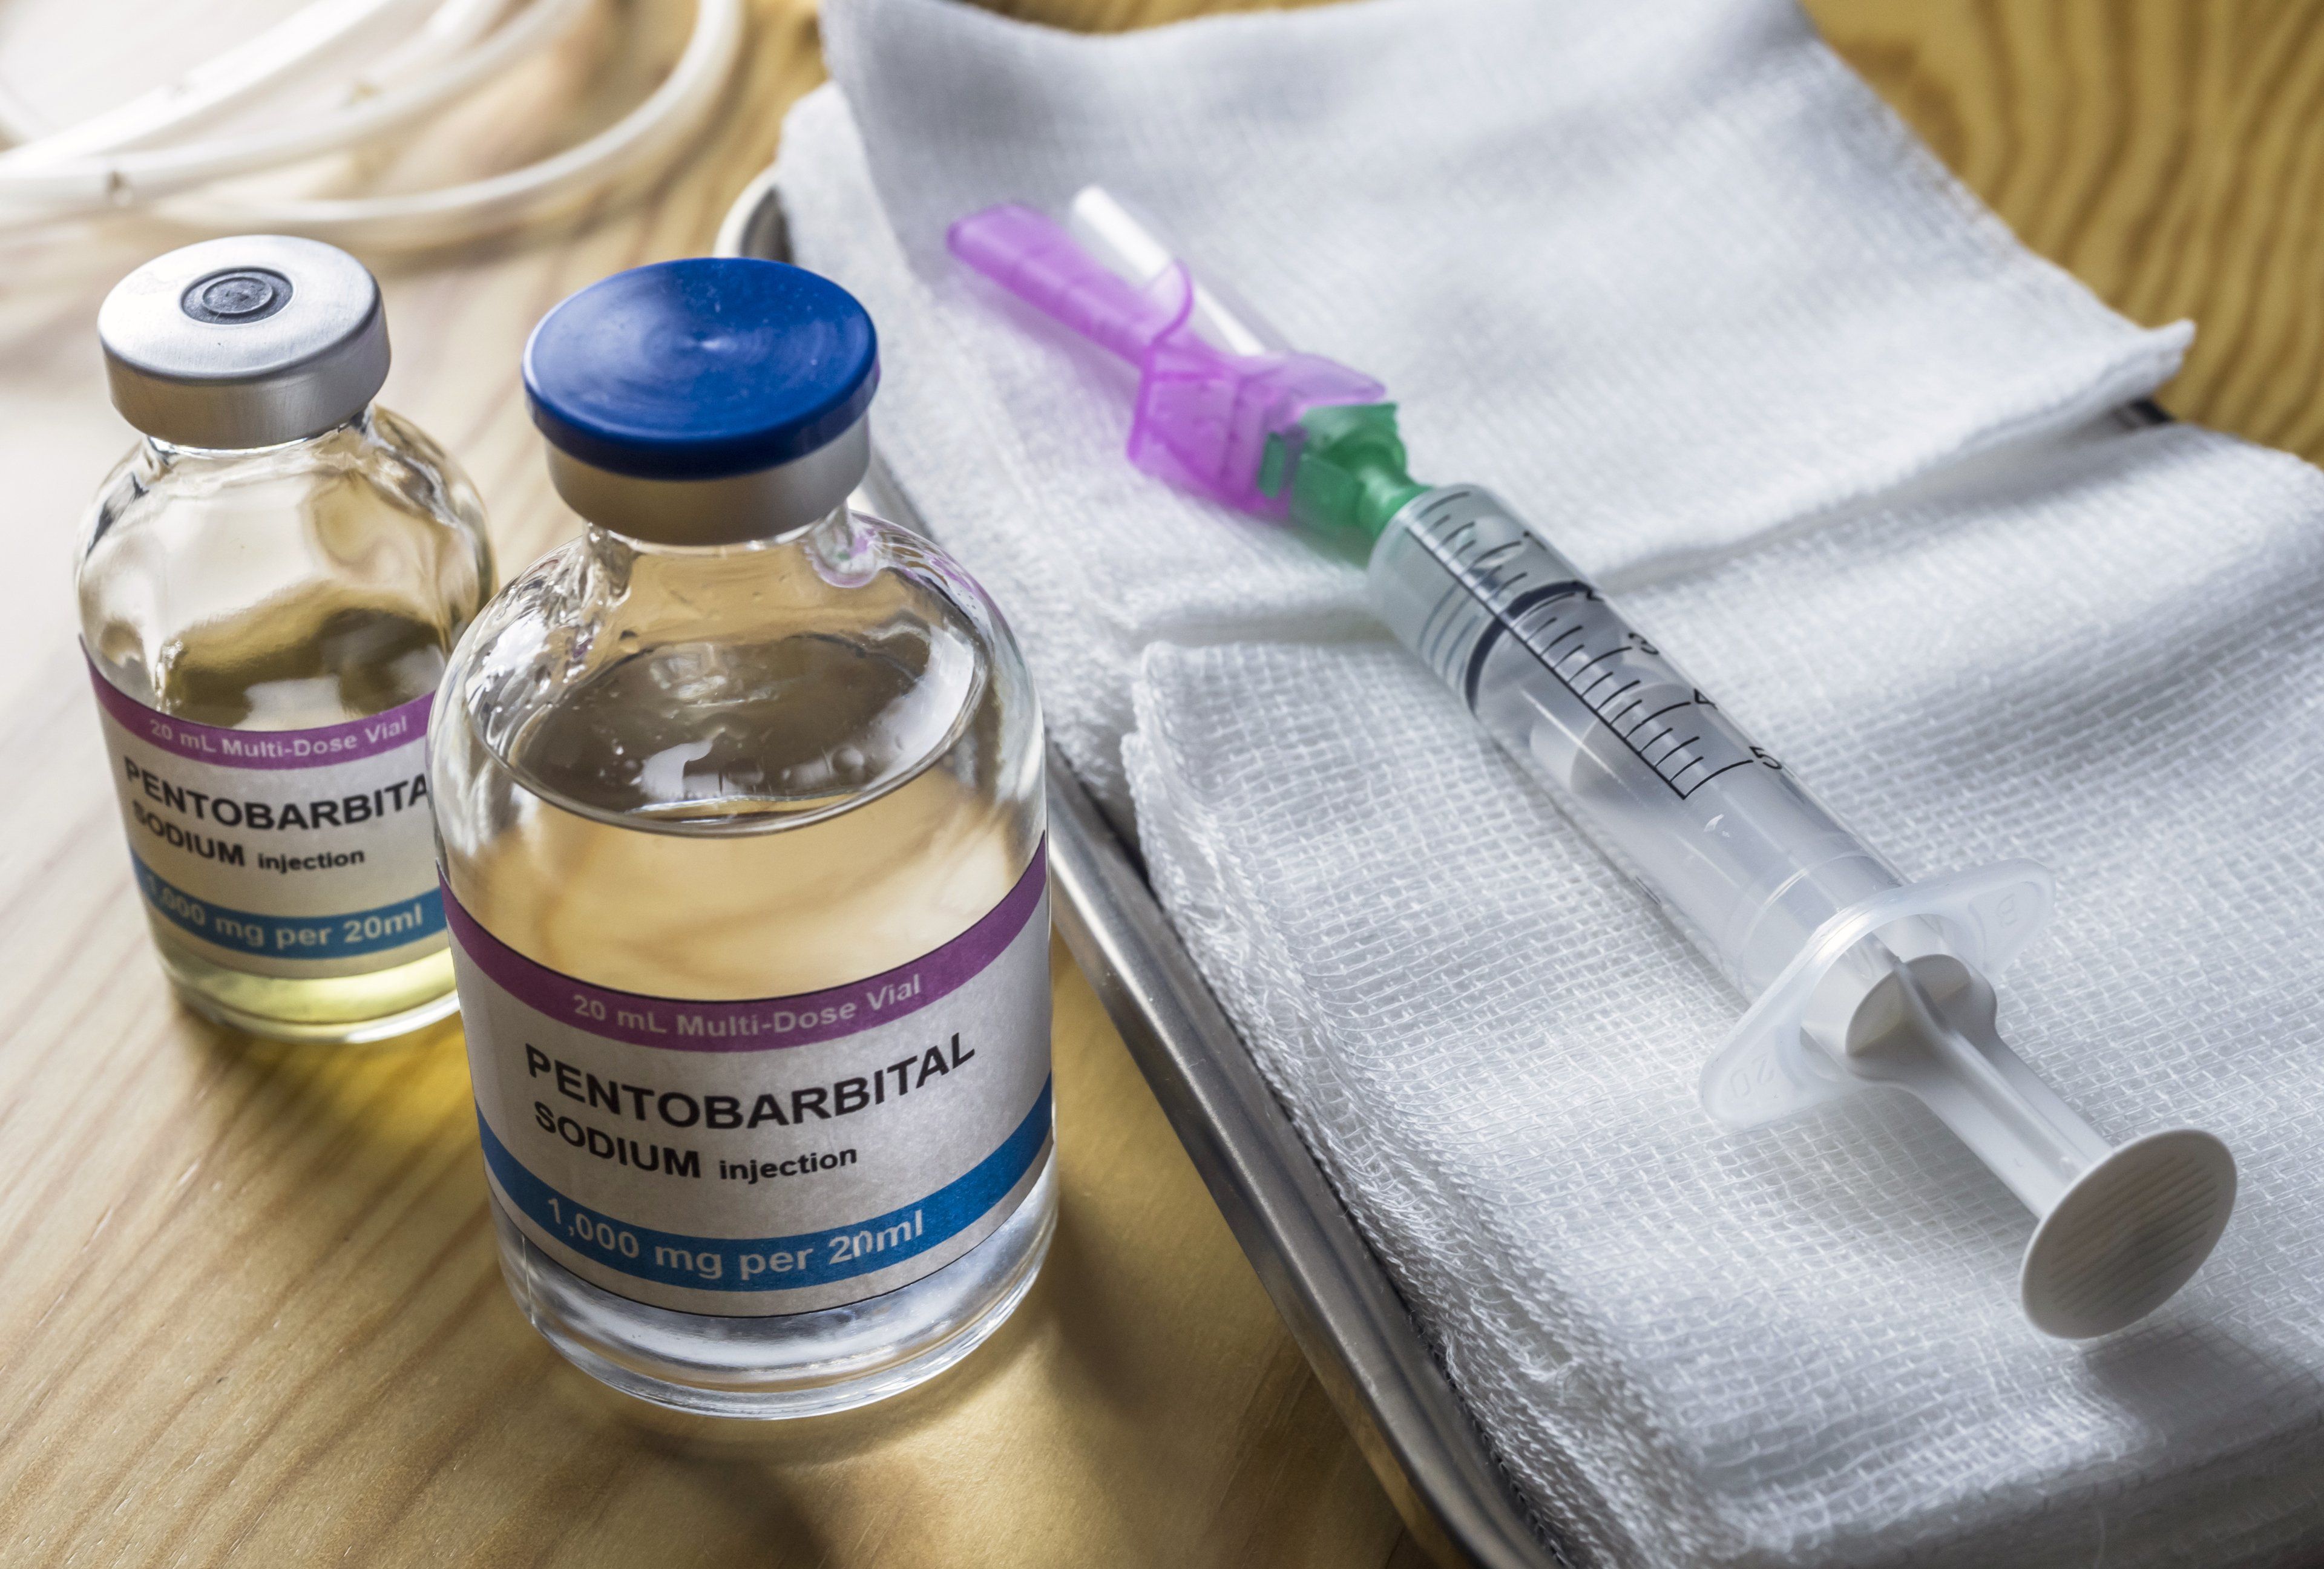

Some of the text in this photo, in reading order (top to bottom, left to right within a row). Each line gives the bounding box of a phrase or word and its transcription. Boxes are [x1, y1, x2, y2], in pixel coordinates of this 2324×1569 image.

[149, 715, 407, 758] 20 mL Multi-Dose Vial
[1749, 745, 1782, 770] 5
[122, 755, 427, 831] PENTOBARBITA
[131, 799, 365, 874] SODIUM injection
[215, 917, 265, 948] mg
[275, 922, 332, 950] per
[343, 903, 422, 944] 20ml
[573, 973, 921, 1037] 20 mL Multi-Dose Vial
[525, 1032, 975, 1130] PENTOBARBITAL
[535, 1101, 858, 1185] SODIUM injection
[547, 1197, 640, 1259] 1,000
[654, 1240, 723, 1280] mg
[739, 1244, 814, 1280] per
